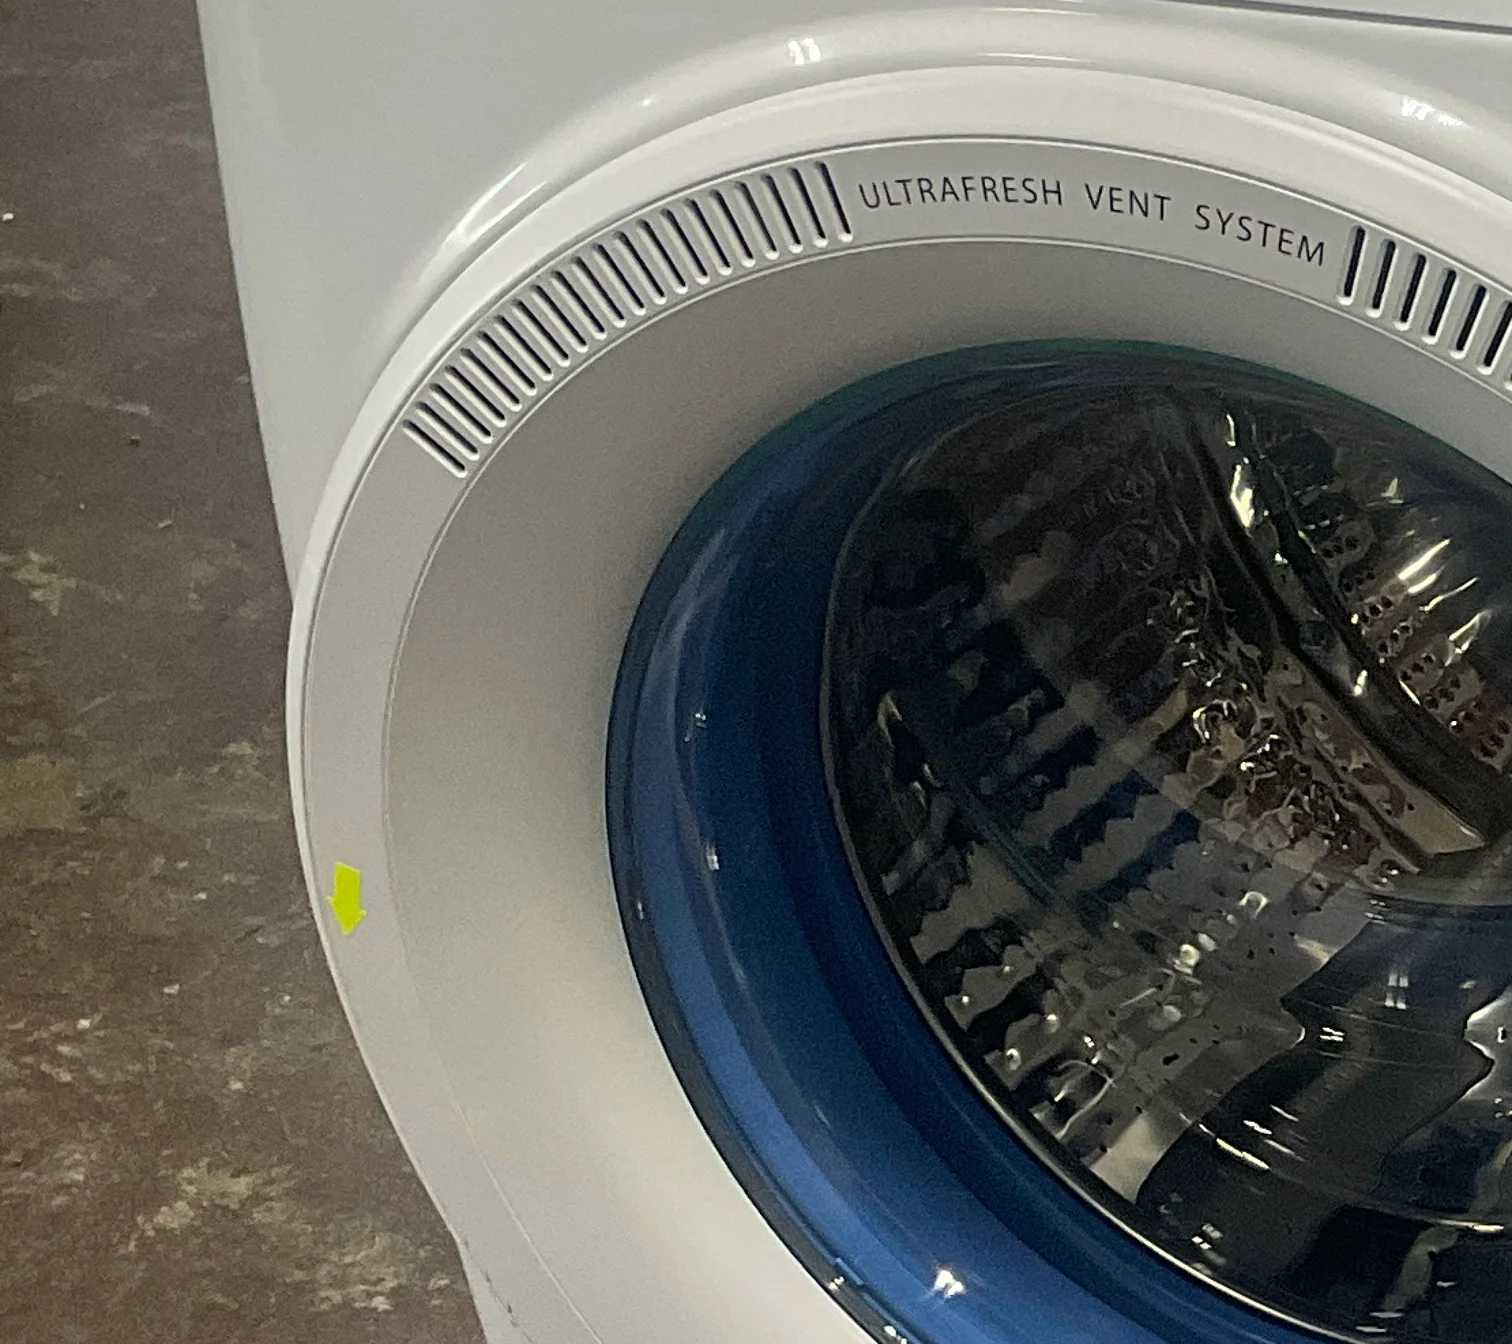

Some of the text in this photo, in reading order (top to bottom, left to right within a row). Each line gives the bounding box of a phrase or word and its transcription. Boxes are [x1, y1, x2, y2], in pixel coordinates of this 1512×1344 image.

[857, 174, 1326, 267] ULTRAFRESH VENT SYSTEM
